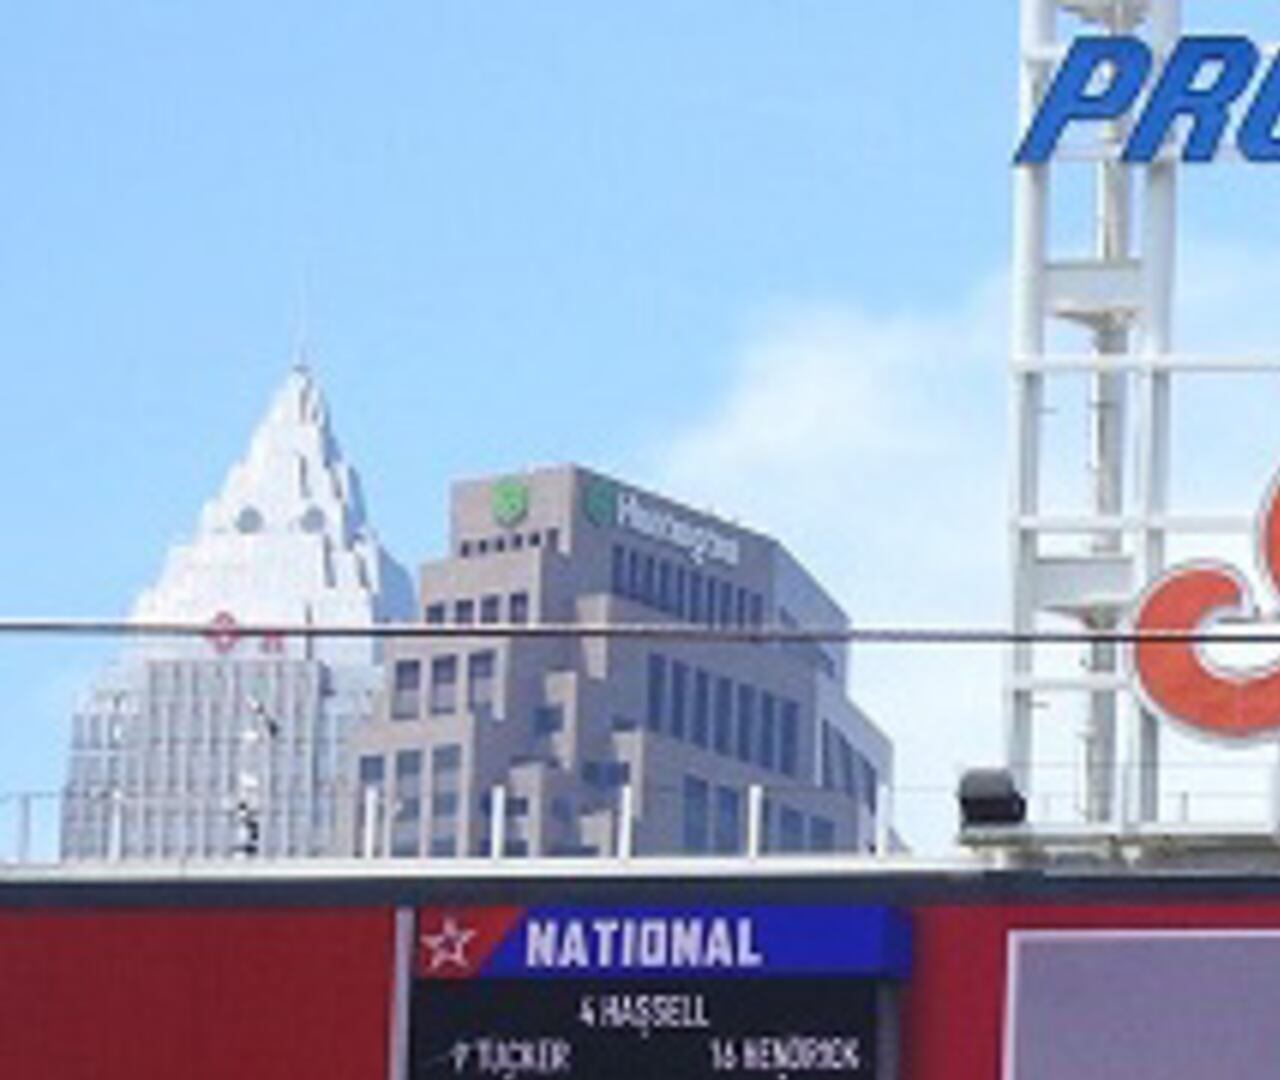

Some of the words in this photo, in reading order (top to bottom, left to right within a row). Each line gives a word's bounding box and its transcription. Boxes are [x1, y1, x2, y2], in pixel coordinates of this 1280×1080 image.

[525, 917, 763, 968] NATIONAL
[600, 996, 710, 1027] HASSELL
[478, 1039, 571, 1073] TUCKER
